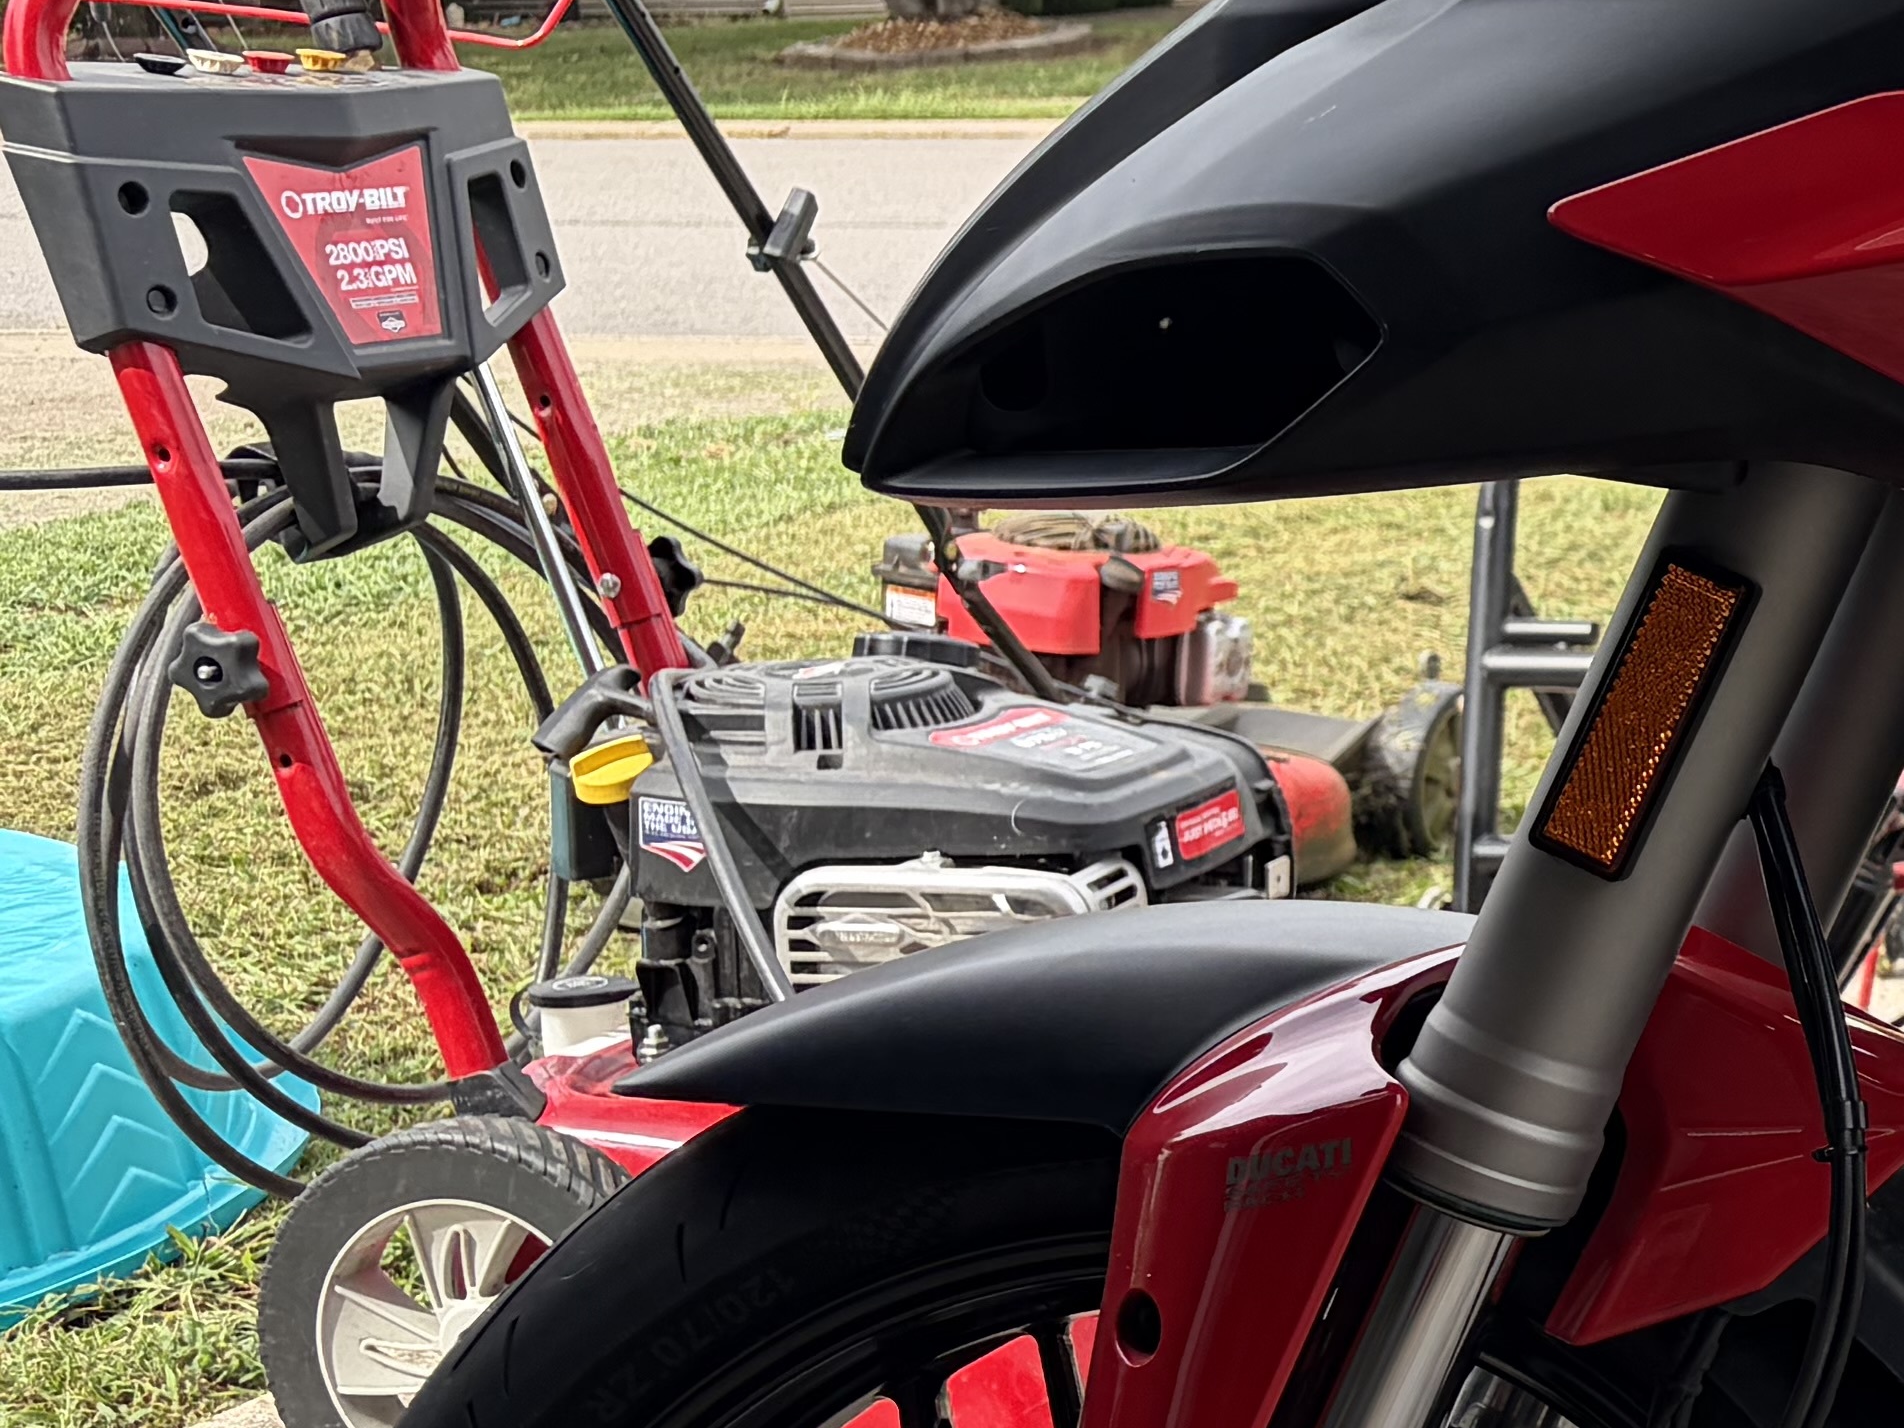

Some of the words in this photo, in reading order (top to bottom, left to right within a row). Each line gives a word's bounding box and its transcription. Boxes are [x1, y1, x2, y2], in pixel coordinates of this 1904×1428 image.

[301, 186, 409, 215] TROY-BILT
[325, 240, 373, 266] 2800
[378, 237, 409, 260] PSI
[337, 268, 367, 291] 2.3
[371, 262, 417, 287] GPM
[1226, 1137, 1352, 1185] DUCATI
